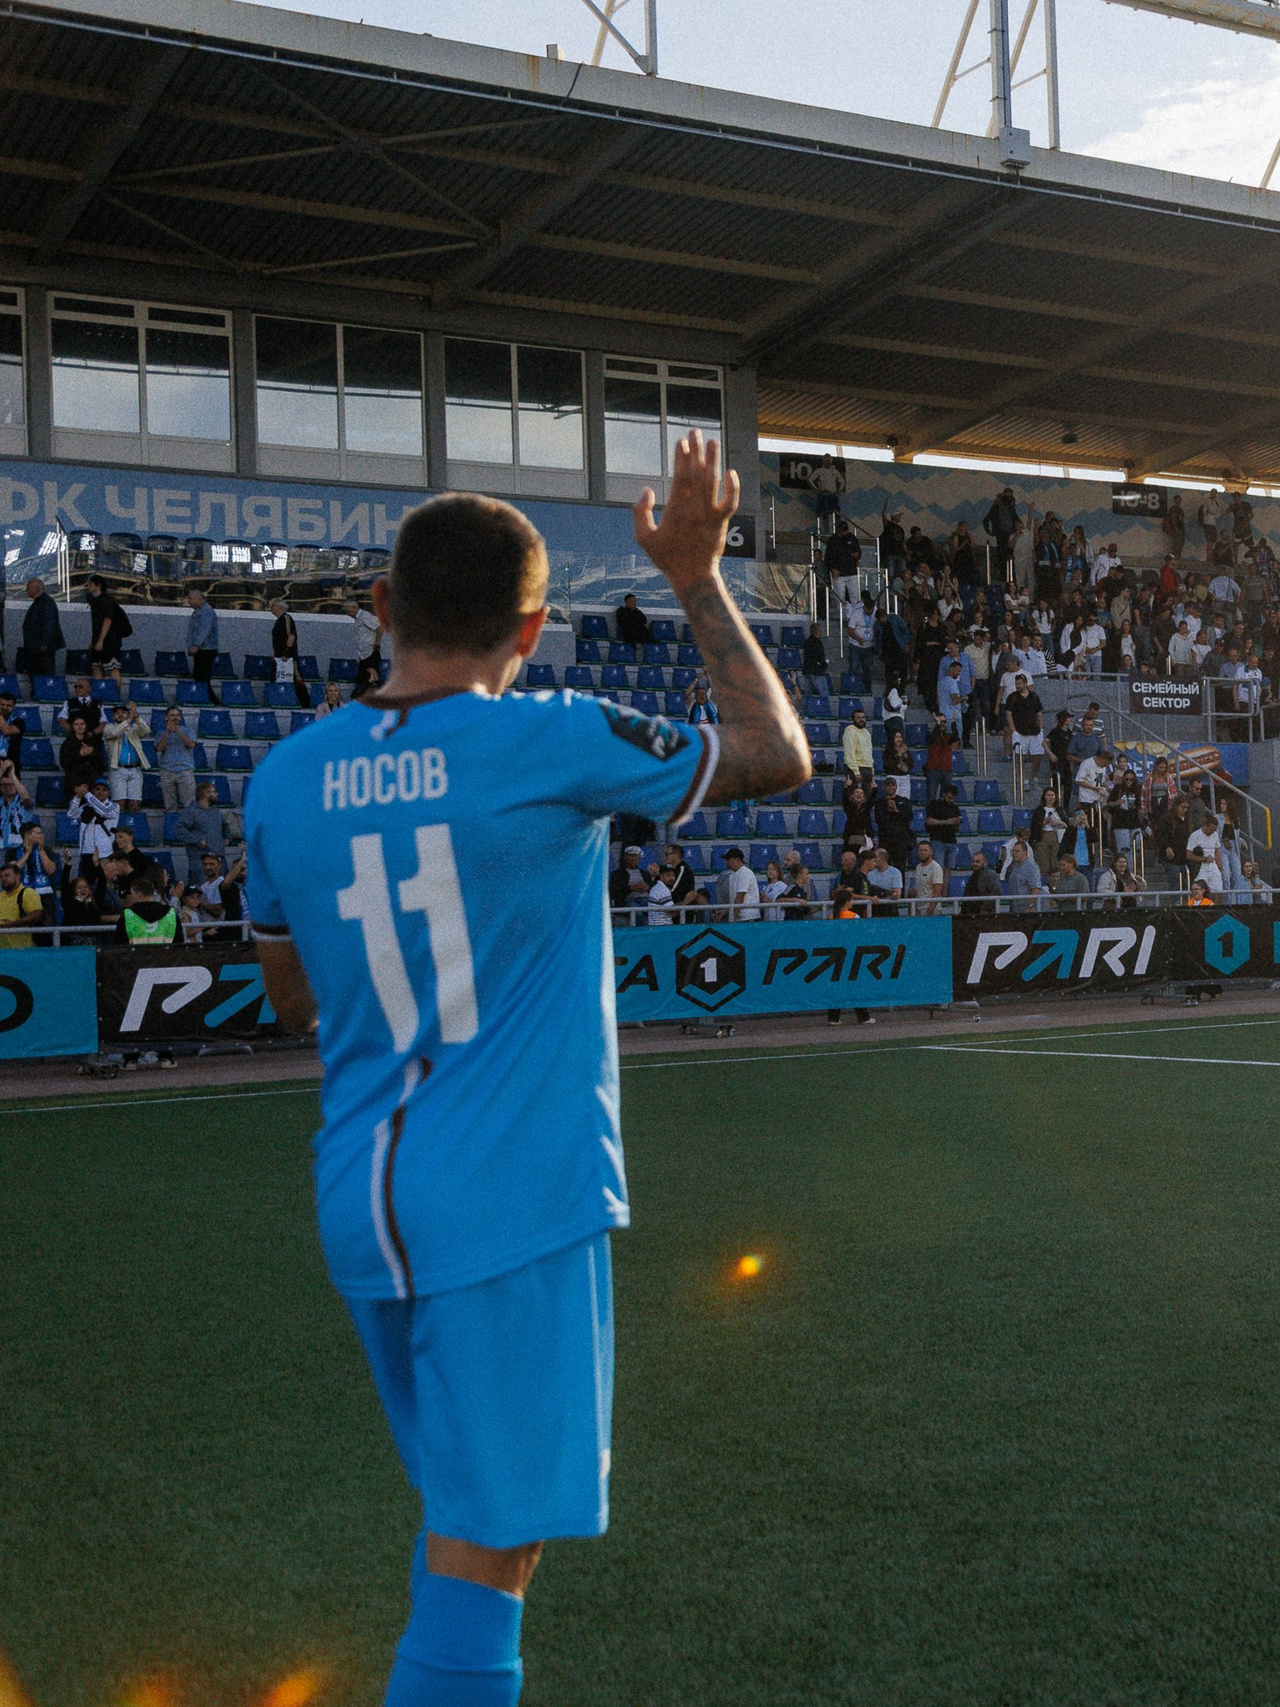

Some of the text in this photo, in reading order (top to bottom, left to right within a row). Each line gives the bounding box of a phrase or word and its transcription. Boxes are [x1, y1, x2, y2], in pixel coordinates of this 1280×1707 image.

[0, 477, 91, 528] ФК
[1132, 679, 1200, 695] СЕМЕЙНЫЙ
[1142, 697, 1191, 709] СЕКТОР
[322, 747, 449, 811] НОСОВ
[336, 823, 480, 1054] 11
[966, 925, 1156, 984] PARI
[700, 957, 718, 982] 1
[763, 943, 907, 986] PARI
